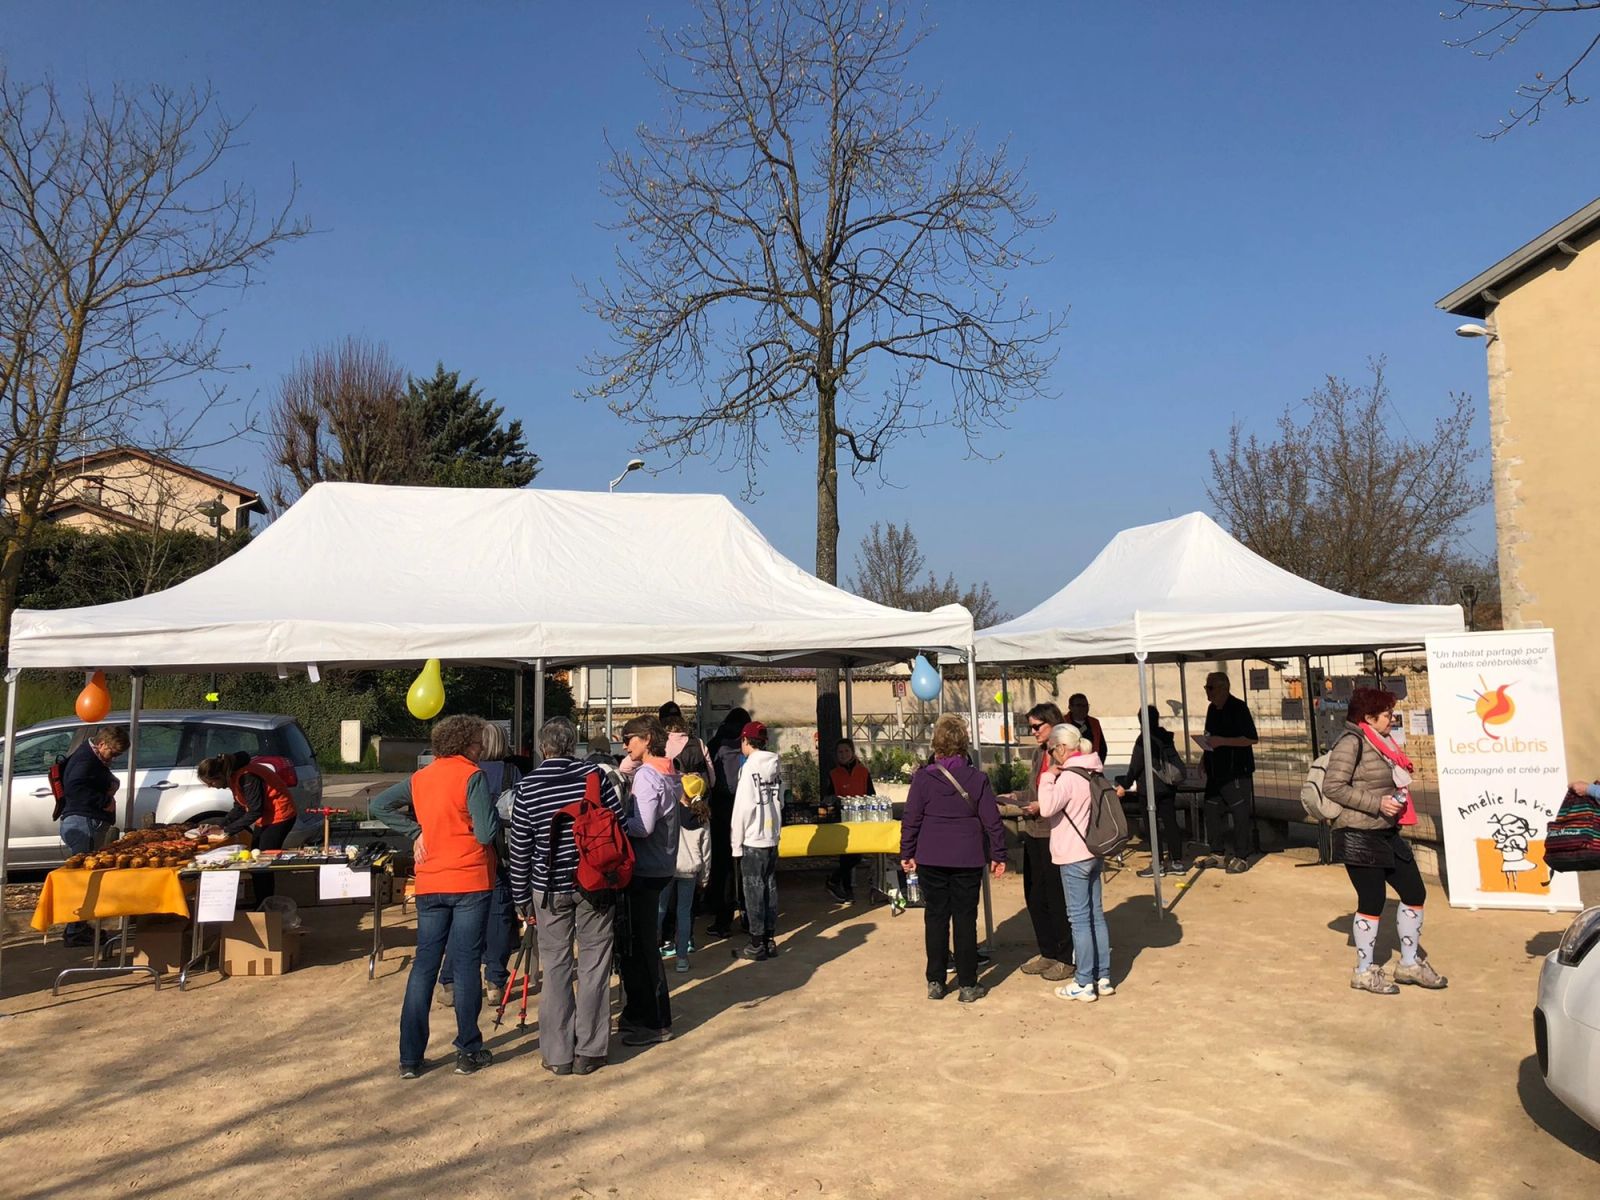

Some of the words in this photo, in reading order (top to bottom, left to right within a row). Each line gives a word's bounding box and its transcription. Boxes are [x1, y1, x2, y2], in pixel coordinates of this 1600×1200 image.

[1451, 648, 1484, 658] habitat
[1486, 647, 1523, 659] partagé
[1525, 647, 1549, 656] pour
[1439, 659, 1474, 669] adultes
[1442, 767, 1504, 776] Accompagné
[1519, 766, 1540, 774] créé
[1543, 766, 1560, 774] par
[1457, 790, 1504, 820] Amélie
[1514, 788, 1527, 806] la
[1533, 799, 1554, 817] vie
